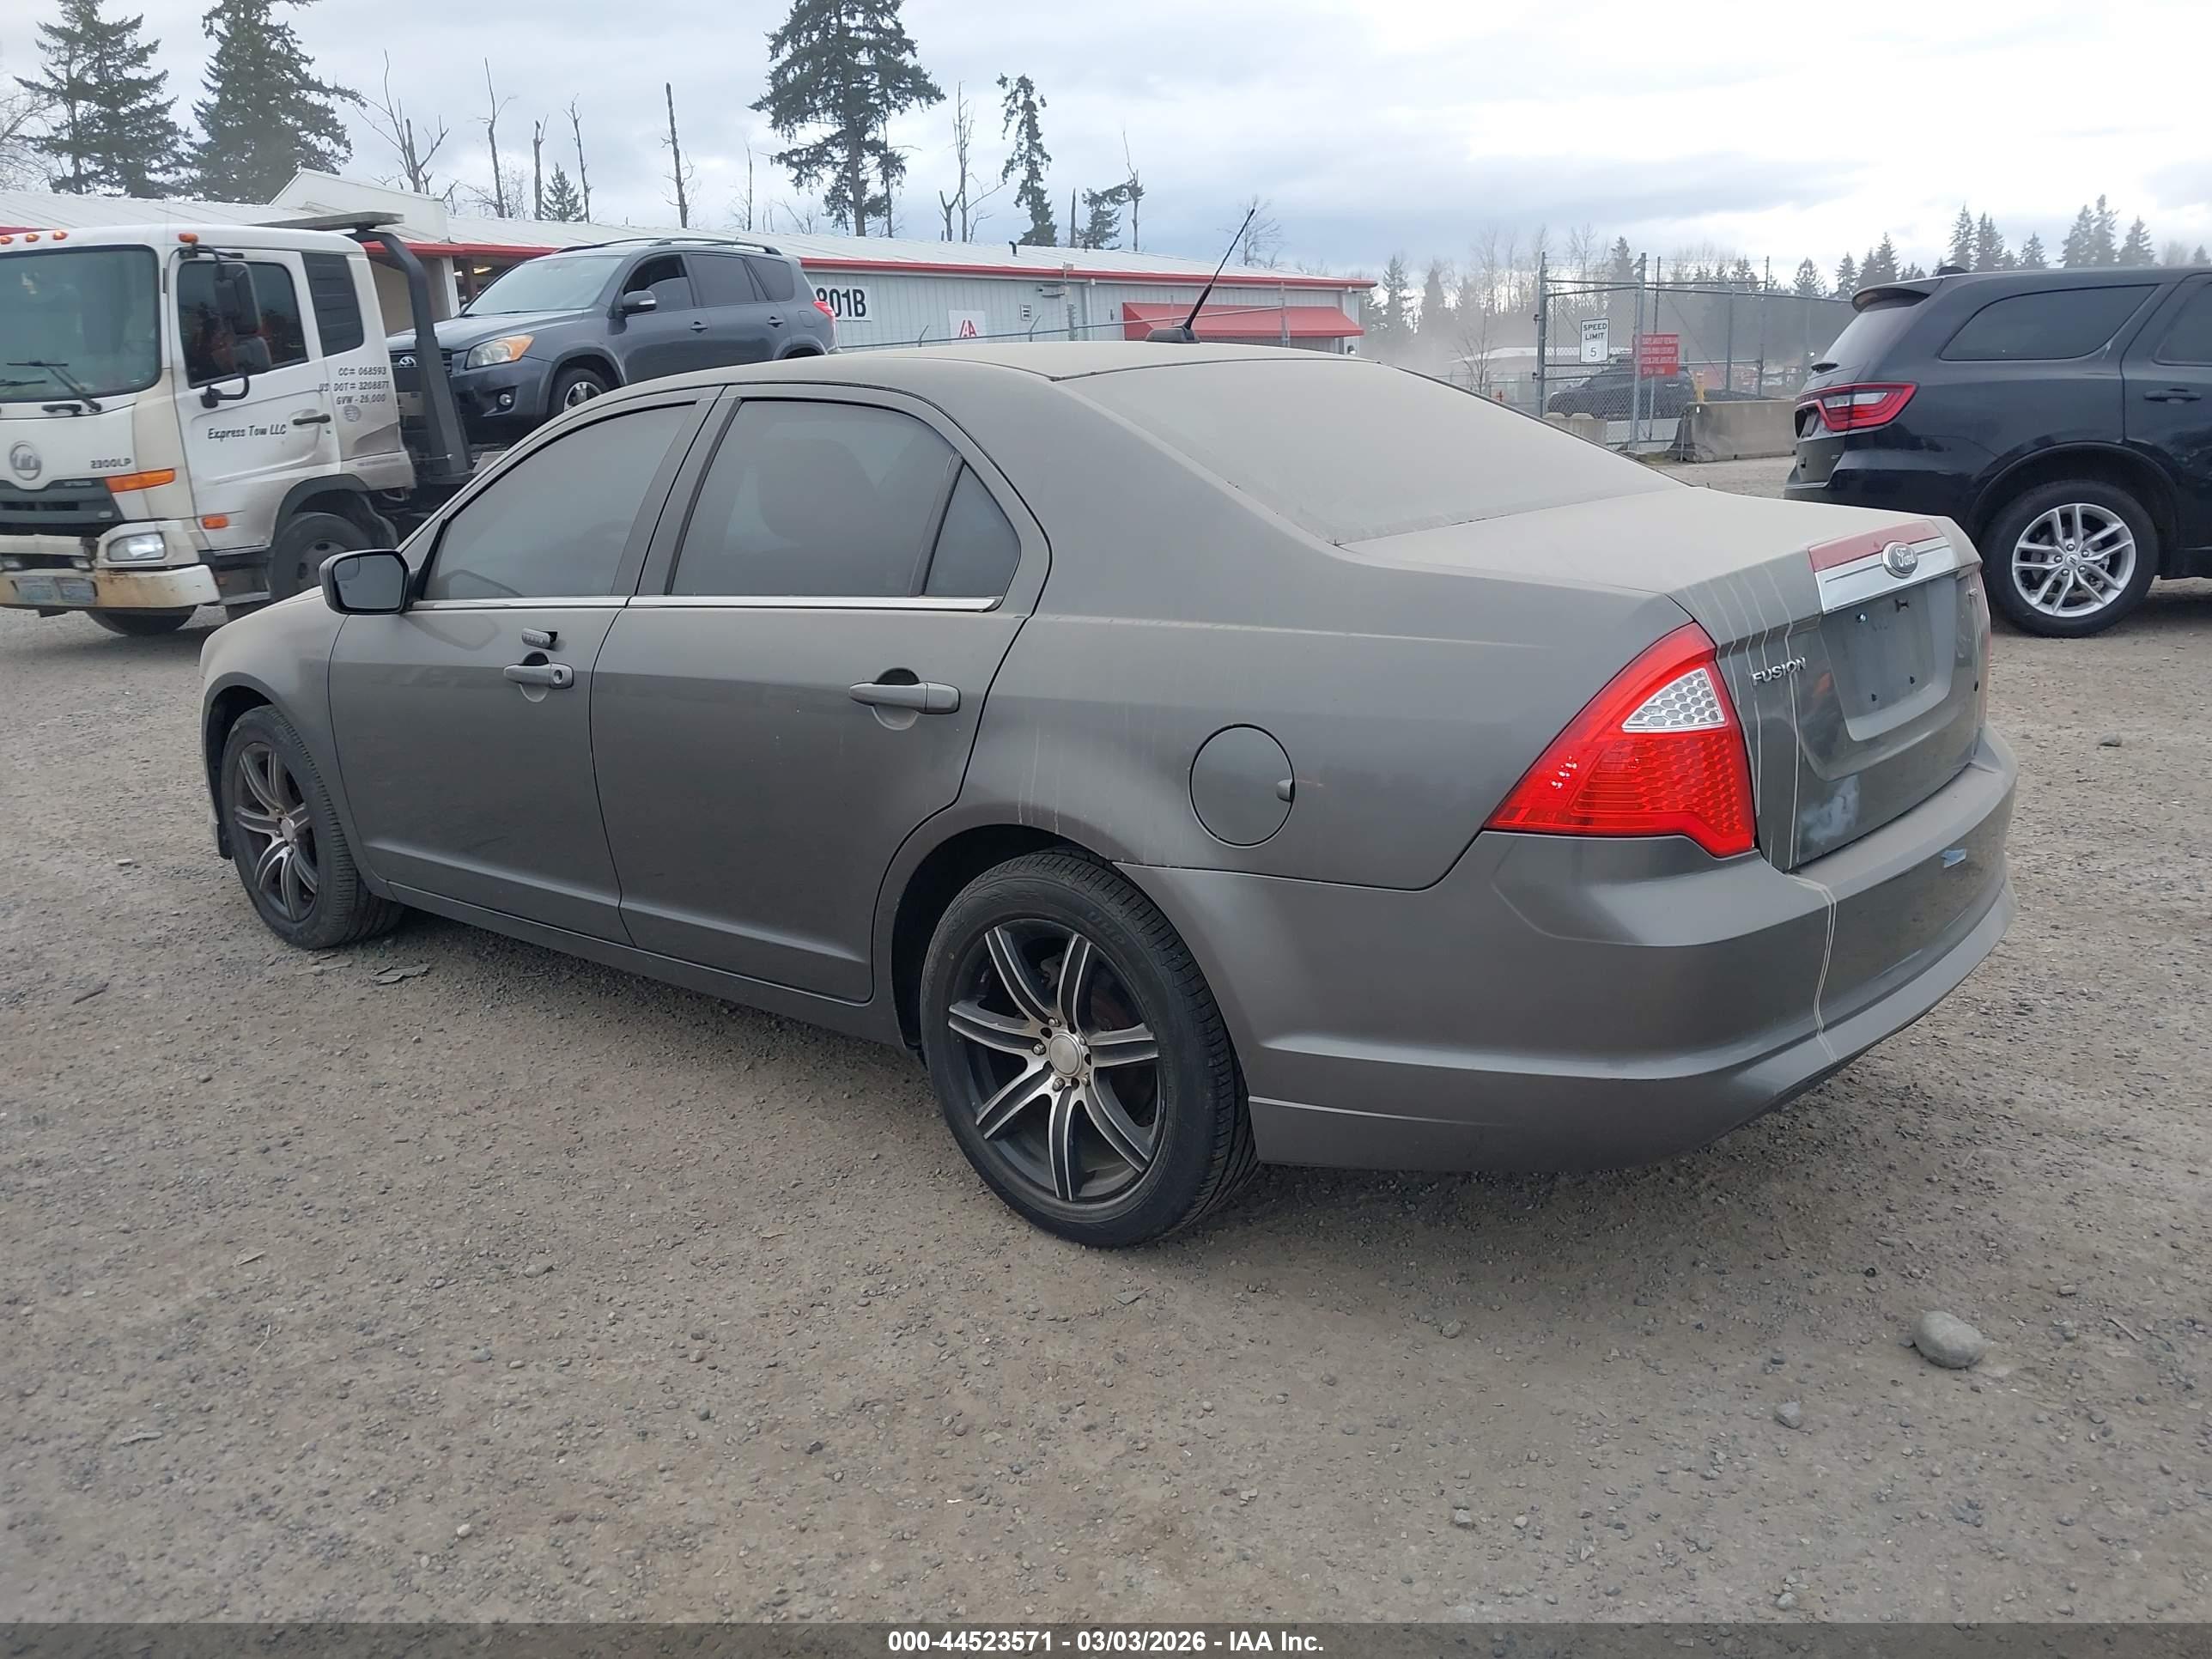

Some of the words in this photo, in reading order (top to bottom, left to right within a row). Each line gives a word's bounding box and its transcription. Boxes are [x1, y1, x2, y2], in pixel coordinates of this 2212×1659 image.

[1583, 323, 1607, 331] SPEED
[1585, 332, 1605, 341] LIMIT
[1590, 347, 1597, 357] 5
[319, 383, 330, 392] US
[336, 396, 354, 405] GVW
[208, 428, 245, 442] Express
[248, 424, 267, 436] Tow
[270, 423, 287, 435] LLC
[1895, 547, 1916, 568] Ford
[1752, 657, 1807, 686] FUSION
